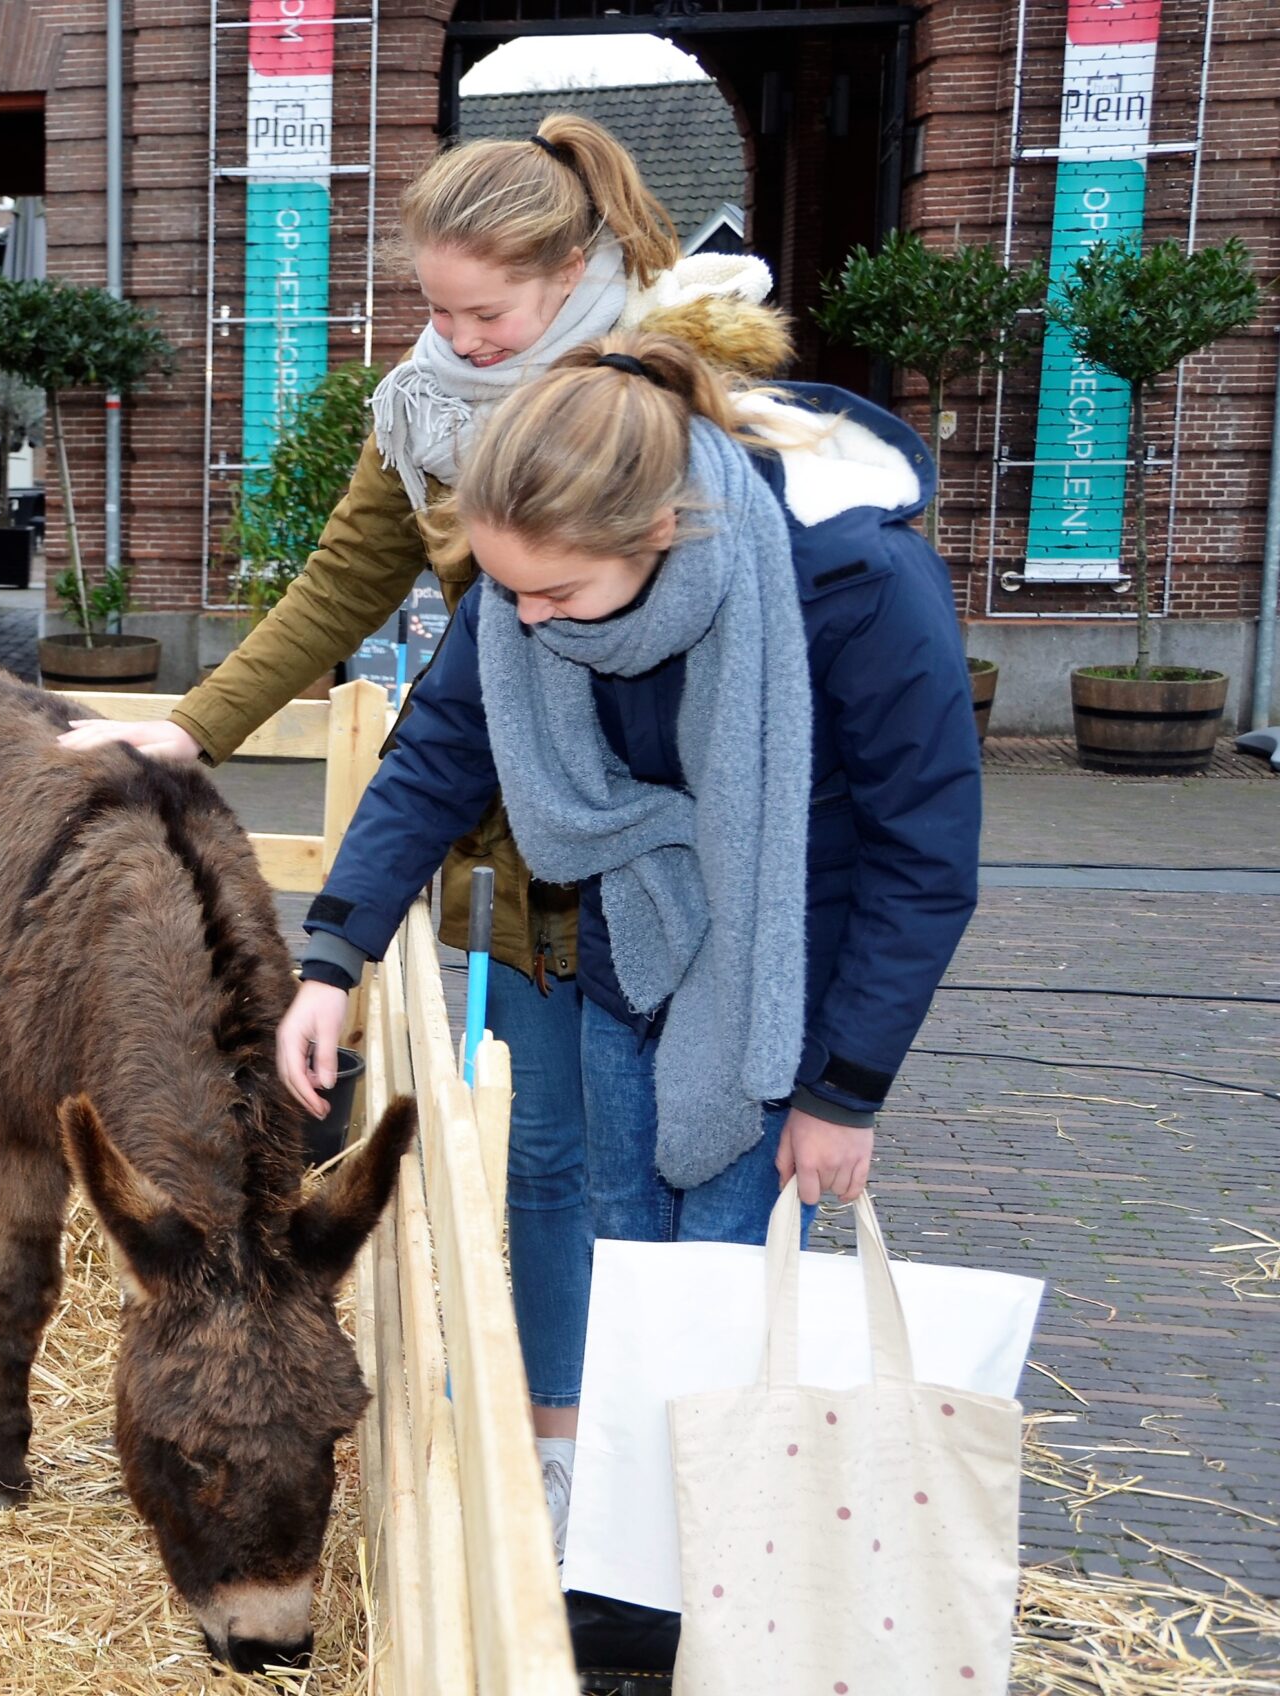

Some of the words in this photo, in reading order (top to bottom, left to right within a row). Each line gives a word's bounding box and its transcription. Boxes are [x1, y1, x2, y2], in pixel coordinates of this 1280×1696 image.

[1064, 89, 1145, 122] Plein
[255, 116, 324, 147] Plein
[1082, 187, 1110, 230] OP
[276, 209, 300, 250] OP
[274, 258, 299, 315] HET
